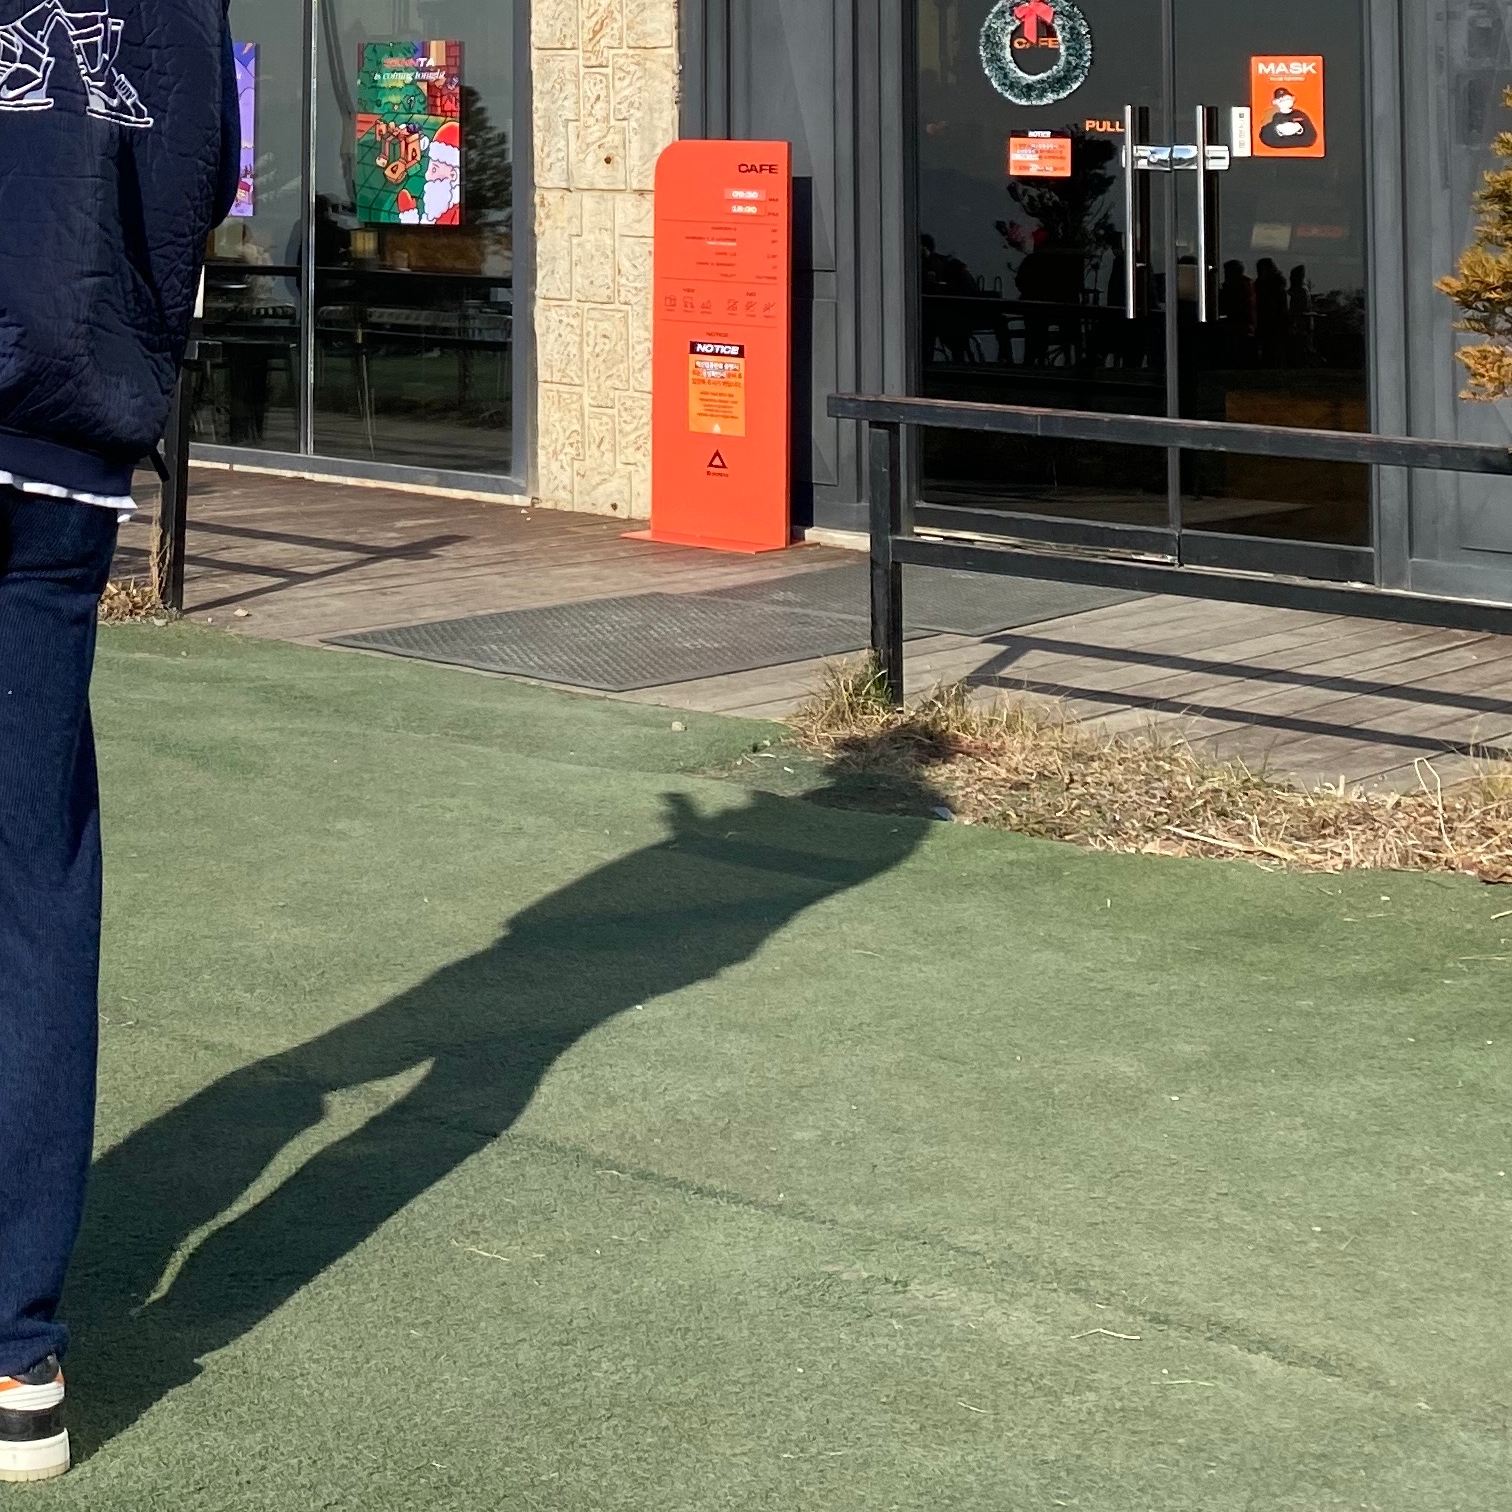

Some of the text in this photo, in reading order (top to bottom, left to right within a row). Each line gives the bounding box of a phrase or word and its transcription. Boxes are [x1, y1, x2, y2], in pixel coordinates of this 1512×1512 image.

[1013, 37, 1060, 49] CFE
[1257, 62, 1317, 75] MASK
[1085, 119, 1125, 132] PULL
[737, 163, 779, 175] CAFE
[696, 343, 740, 355] NOTICE
